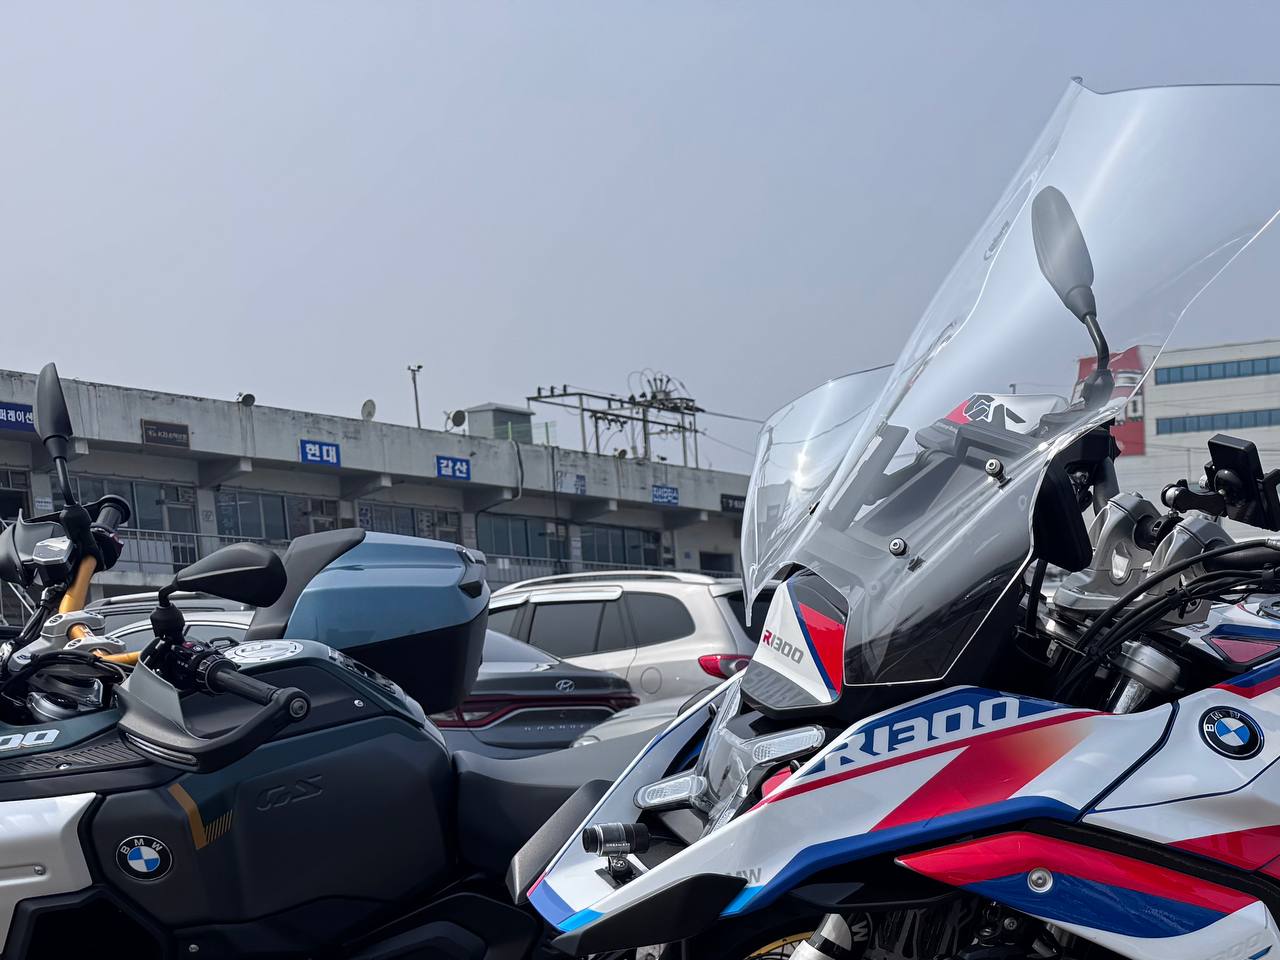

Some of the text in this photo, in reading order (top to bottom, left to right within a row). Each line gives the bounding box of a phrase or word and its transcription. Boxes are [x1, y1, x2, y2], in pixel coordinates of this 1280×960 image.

[305, 443, 337, 464] 현대
[439, 459, 468, 477] 갈산
[824, 696, 1020, 771] R1300
